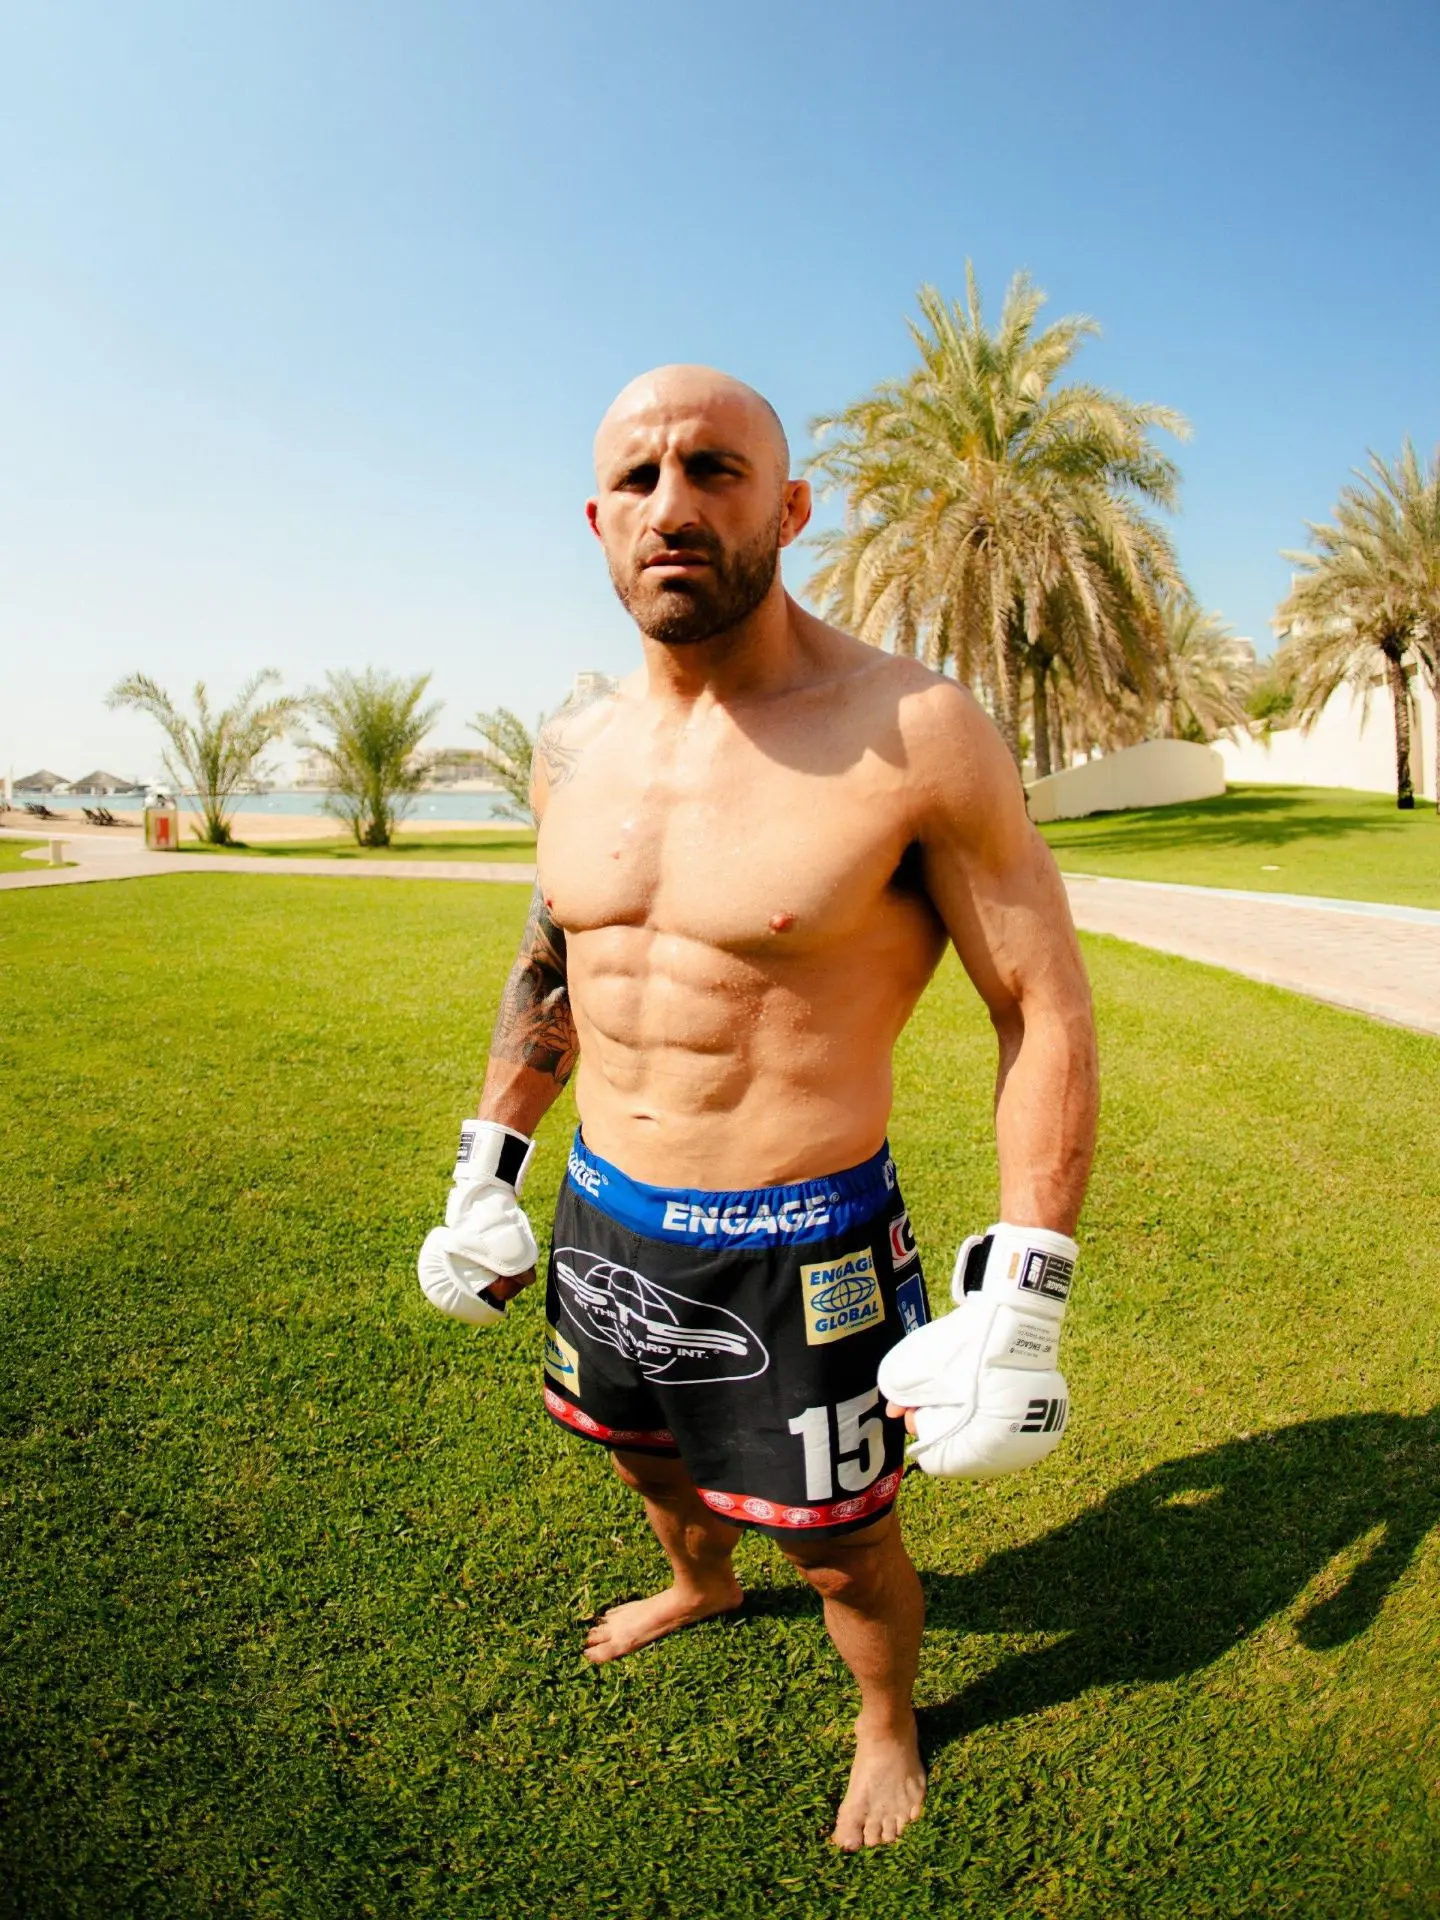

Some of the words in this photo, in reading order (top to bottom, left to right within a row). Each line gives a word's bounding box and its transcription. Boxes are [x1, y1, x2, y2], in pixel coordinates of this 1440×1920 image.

[662, 1195, 830, 1235] ENGAGE
[592, 1306, 617, 1320] THE
[677, 1348, 709, 1359] INT.
[815, 1301, 879, 1332] GLOBAL
[788, 1385, 886, 1501] 15
